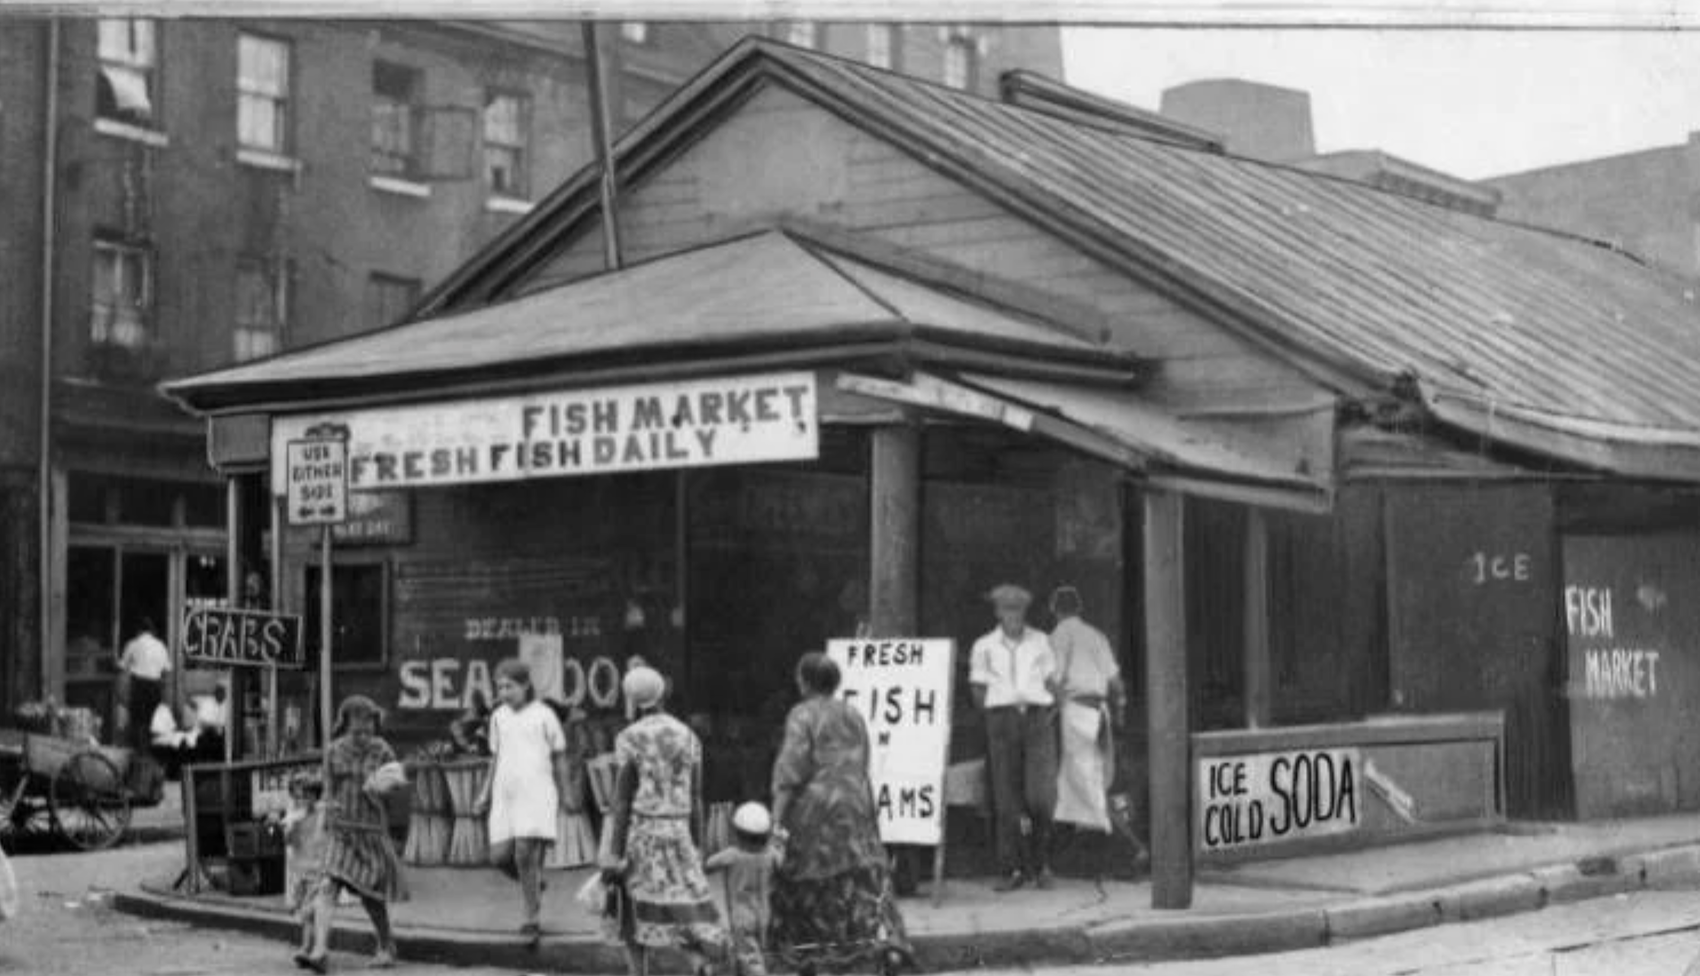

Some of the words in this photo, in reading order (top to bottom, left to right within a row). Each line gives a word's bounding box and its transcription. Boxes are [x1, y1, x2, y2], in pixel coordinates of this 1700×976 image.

[522, 401, 618, 439] FISH
[631, 386, 809, 430] MARKET
[351, 446, 477, 484] FRESH
[489, 437, 582, 471] FISH
[593, 429, 716, 466] DAILY
[1474, 553, 1531, 584] ICE
[1565, 584, 1613, 638] FISH
[183, 612, 286, 660] CRABS
[848, 643, 924, 667] FRESH
[1586, 648, 1659, 698] MARKET
[1210, 761, 1248, 799] ICE
[1270, 752, 1355, 834] SODA
[1205, 799, 1264, 846] COLD
